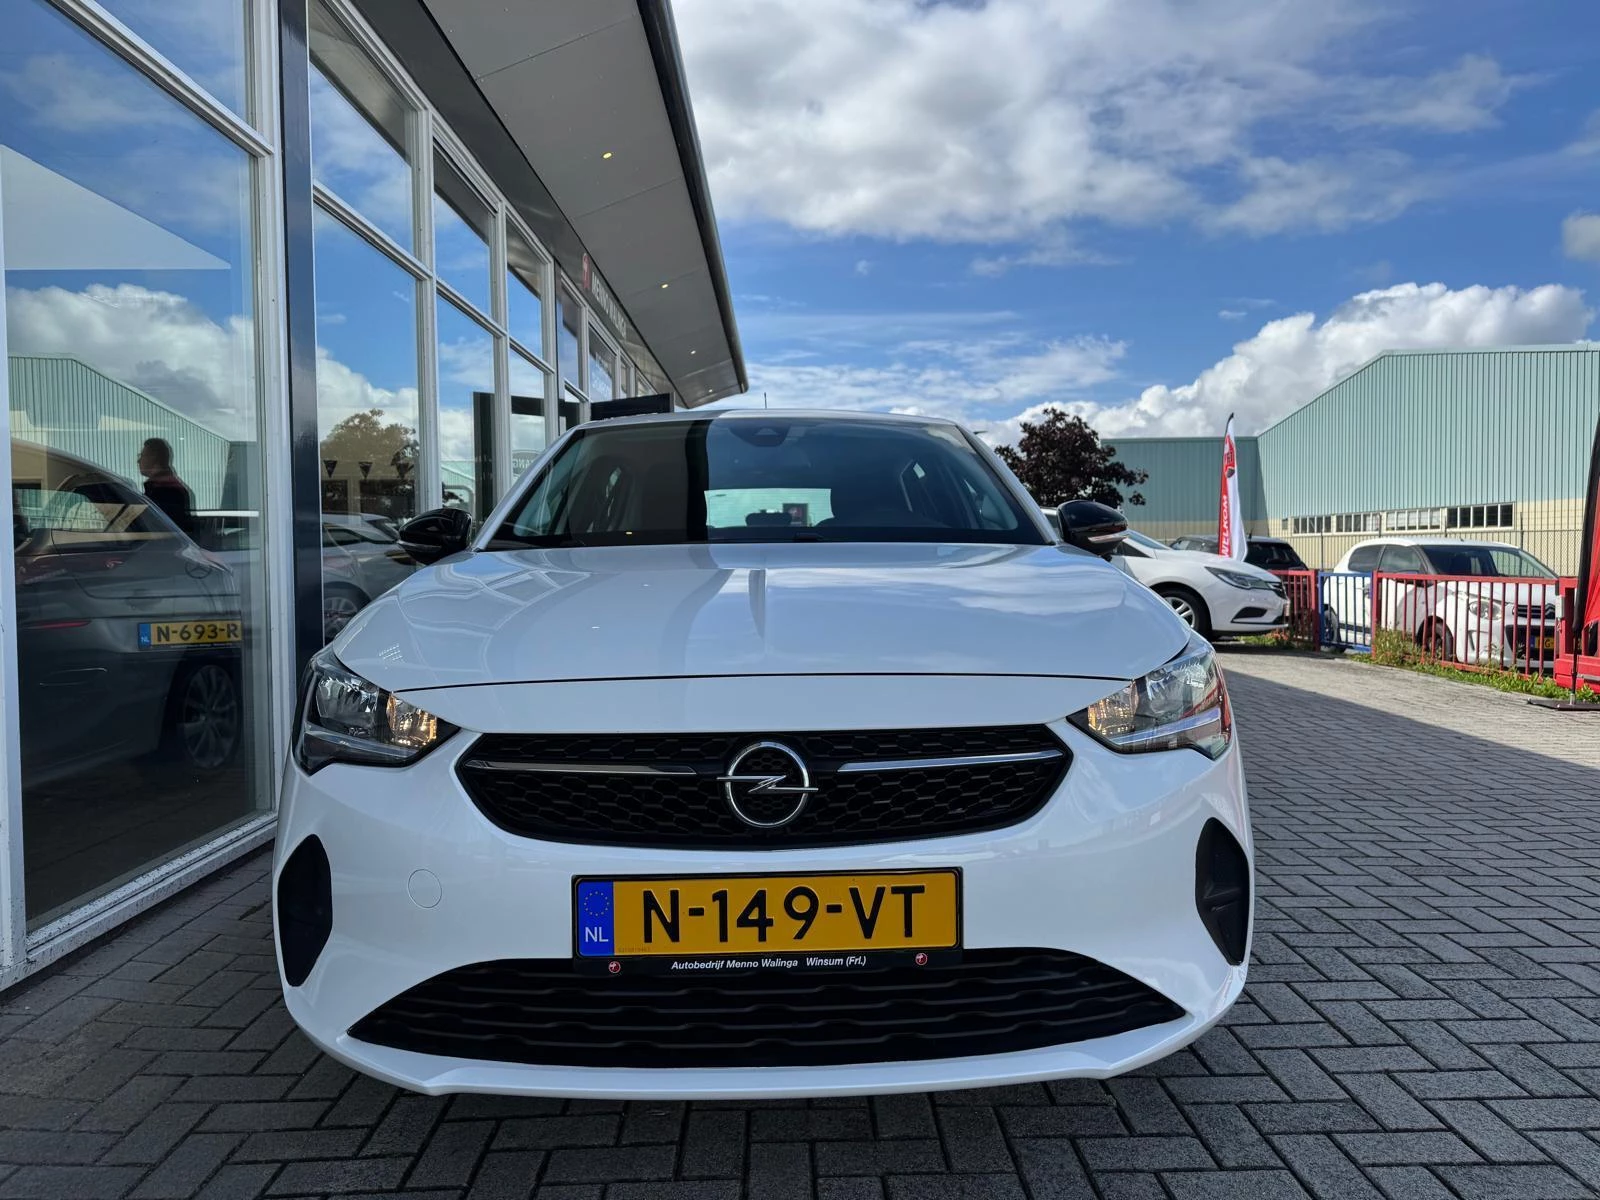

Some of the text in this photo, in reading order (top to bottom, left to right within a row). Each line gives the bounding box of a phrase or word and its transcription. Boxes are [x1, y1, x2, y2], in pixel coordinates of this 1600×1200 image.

[1221, 495, 1229, 558] WELKOM
[643, 885, 925, 943] N-149-VT
[585, 926, 609, 942] NL
[671, 960, 725, 970] Autobedrijf
[726, 959, 759, 968] Menno
[761, 958, 798, 968] Walinga
[806, 957, 844, 966] Winsum
